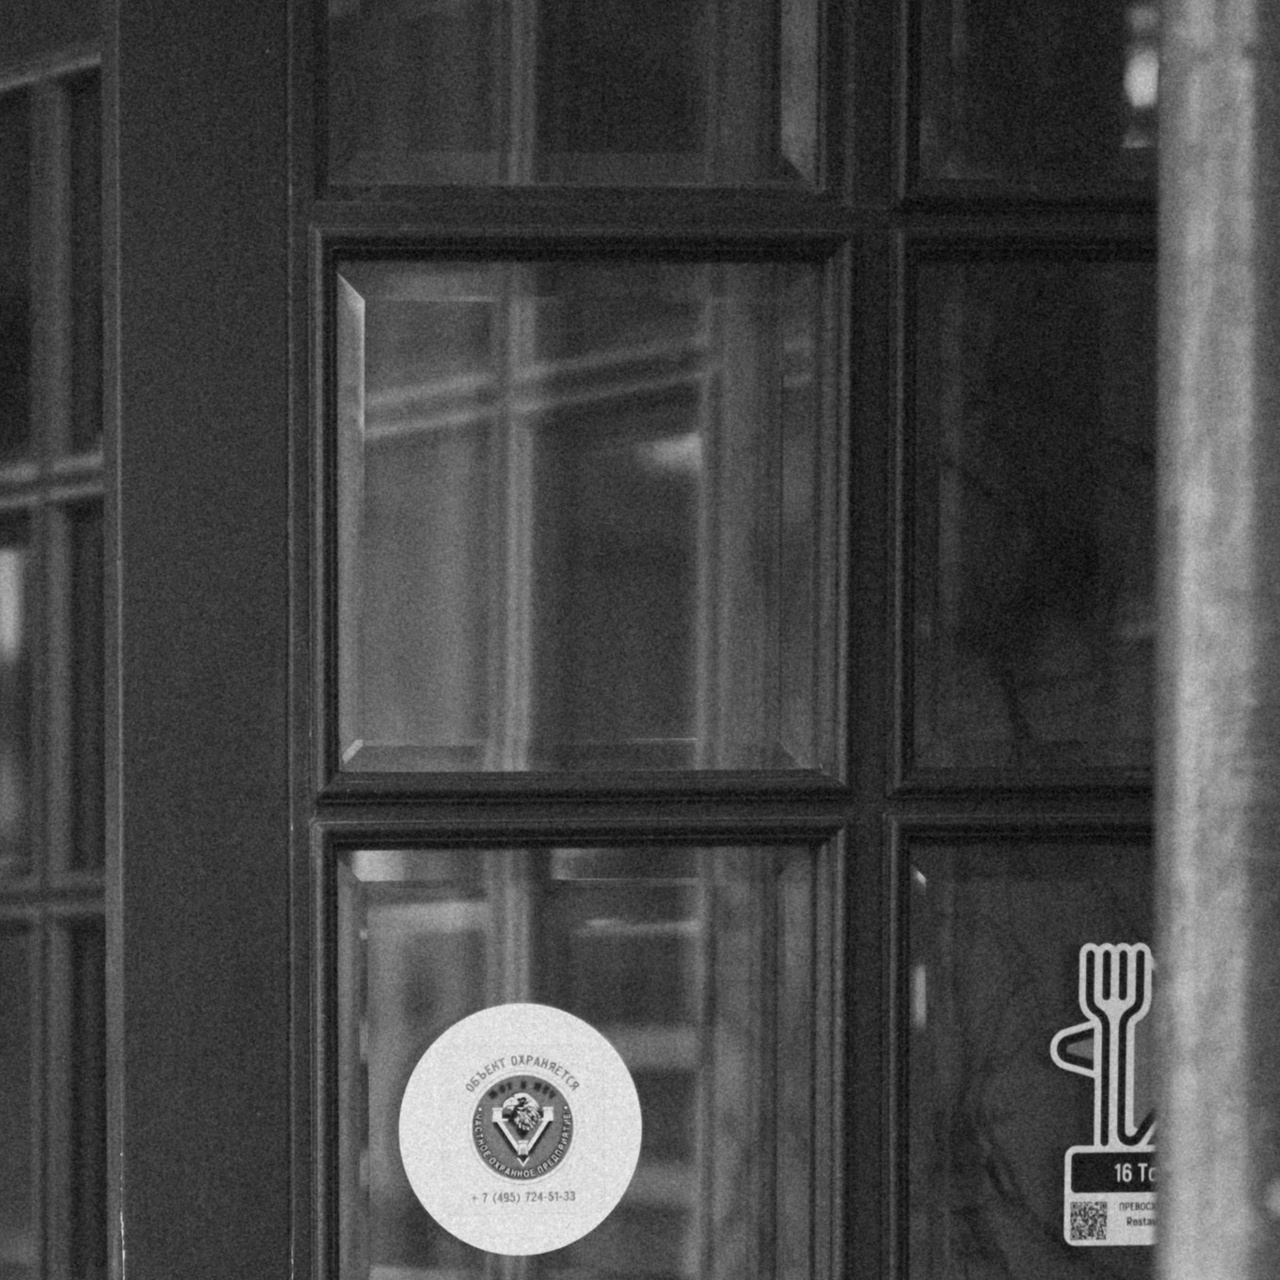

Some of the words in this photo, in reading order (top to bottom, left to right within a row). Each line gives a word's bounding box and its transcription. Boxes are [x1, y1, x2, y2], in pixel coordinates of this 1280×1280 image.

[465, 1057, 507, 1093] ОБЪЕКТ
[510, 1054, 580, 1092] ОХРАНЯЕТСЯ
[473, 1113, 492, 1158] ЧАСТНОЕ
[488, 1156, 537, 1178] ОХРАННОЕ
[536, 1112, 572, 1174] ПРЕДПРИЯТИЕ
[1114, 1162, 1133, 1182] 16
[482, 1192, 488, 1203] 7
[493, 1191, 521, 1205] (495)
[525, 1190, 577, 1203] 724-51-33
